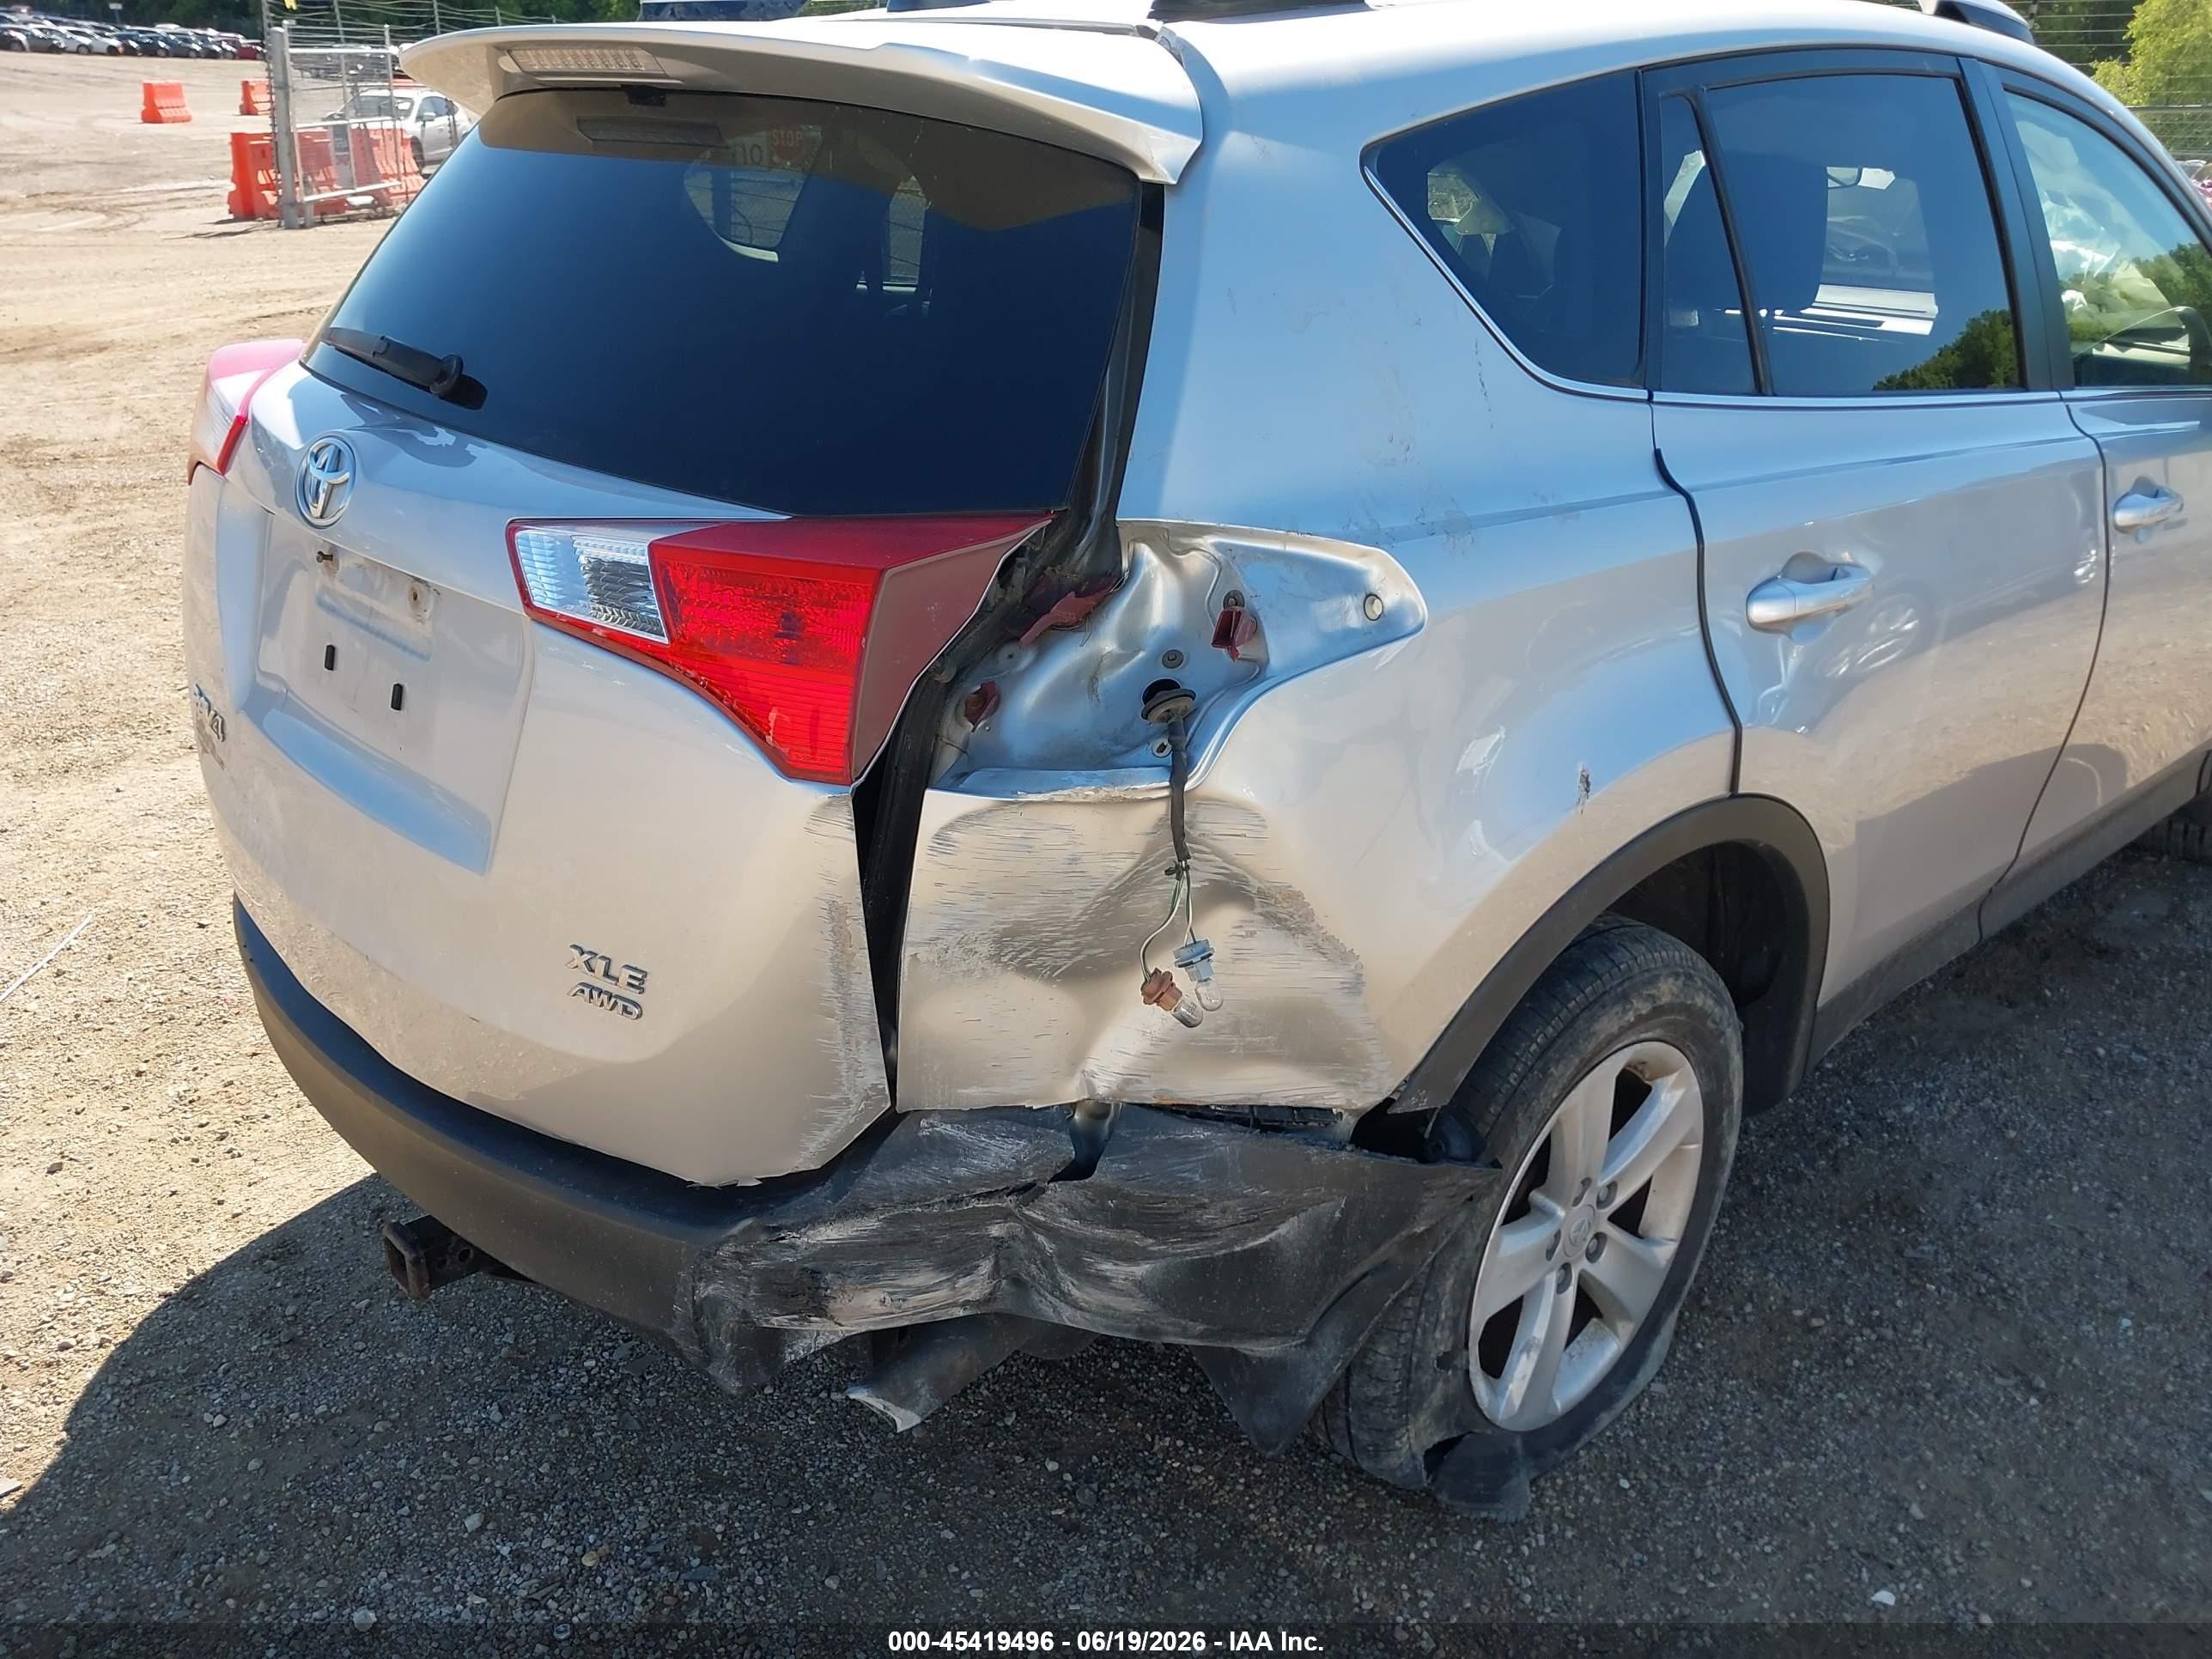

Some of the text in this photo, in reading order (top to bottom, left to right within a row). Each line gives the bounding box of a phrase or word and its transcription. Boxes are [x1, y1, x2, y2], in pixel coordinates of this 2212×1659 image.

[773, 130, 804, 147] STOP
[565, 944, 647, 995] XLE
[568, 981, 643, 1020] AWD
